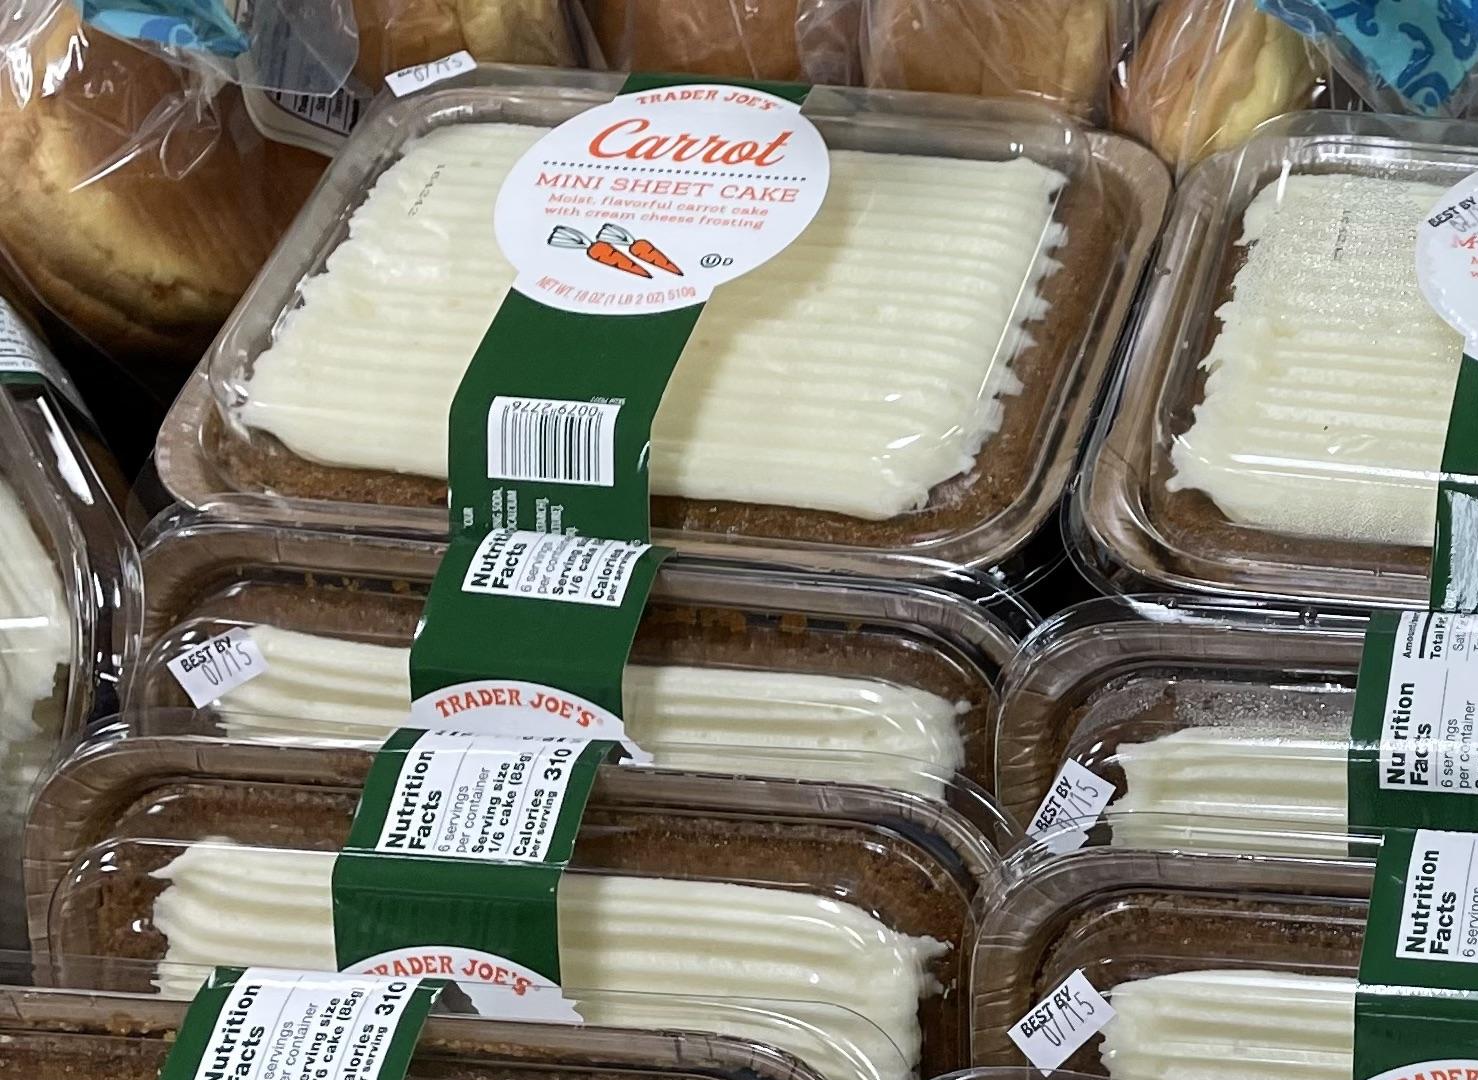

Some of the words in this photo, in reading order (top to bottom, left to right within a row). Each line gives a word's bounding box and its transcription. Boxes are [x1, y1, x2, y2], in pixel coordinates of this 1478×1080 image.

[637, 89, 716, 105] TRADER
[724, 92, 778, 111] JOE'S
[589, 118, 794, 167] Carrot
[536, 172, 604, 191] MINI
[610, 178, 713, 198] SHEET
[720, 184, 800, 203] CAKE
[602, 195, 673, 209] flavorful
[677, 202, 728, 215] carrot
[732, 205, 769, 216] cake
[545, 206, 580, 217] with
[586, 210, 635, 220] cream
[640, 213, 694, 224] cheese
[699, 216, 764, 230] frosting
[1428, 206, 1459, 227] BEST
[1459, 196, 1476, 210] BY
[181, 646, 213, 672] BEST
[214, 636, 231, 654] BY
[435, 687, 522, 718] TRADER
[529, 693, 595, 728] JOE'S
[385, 750, 436, 849] Nutrition
[1036, 796, 1061, 832] BEST
[1056, 776, 1072, 799] BY
[408, 790, 443, 850] Facts
[1404, 849, 1439, 954] Nutrition
[1430, 891, 1457, 955] Facts
[1462, 949, 1475, 958] 6
[462, 960, 534, 996] JOE'S
[1020, 1002, 1053, 1038] BEST
[1054, 985, 1071, 1010] BY
